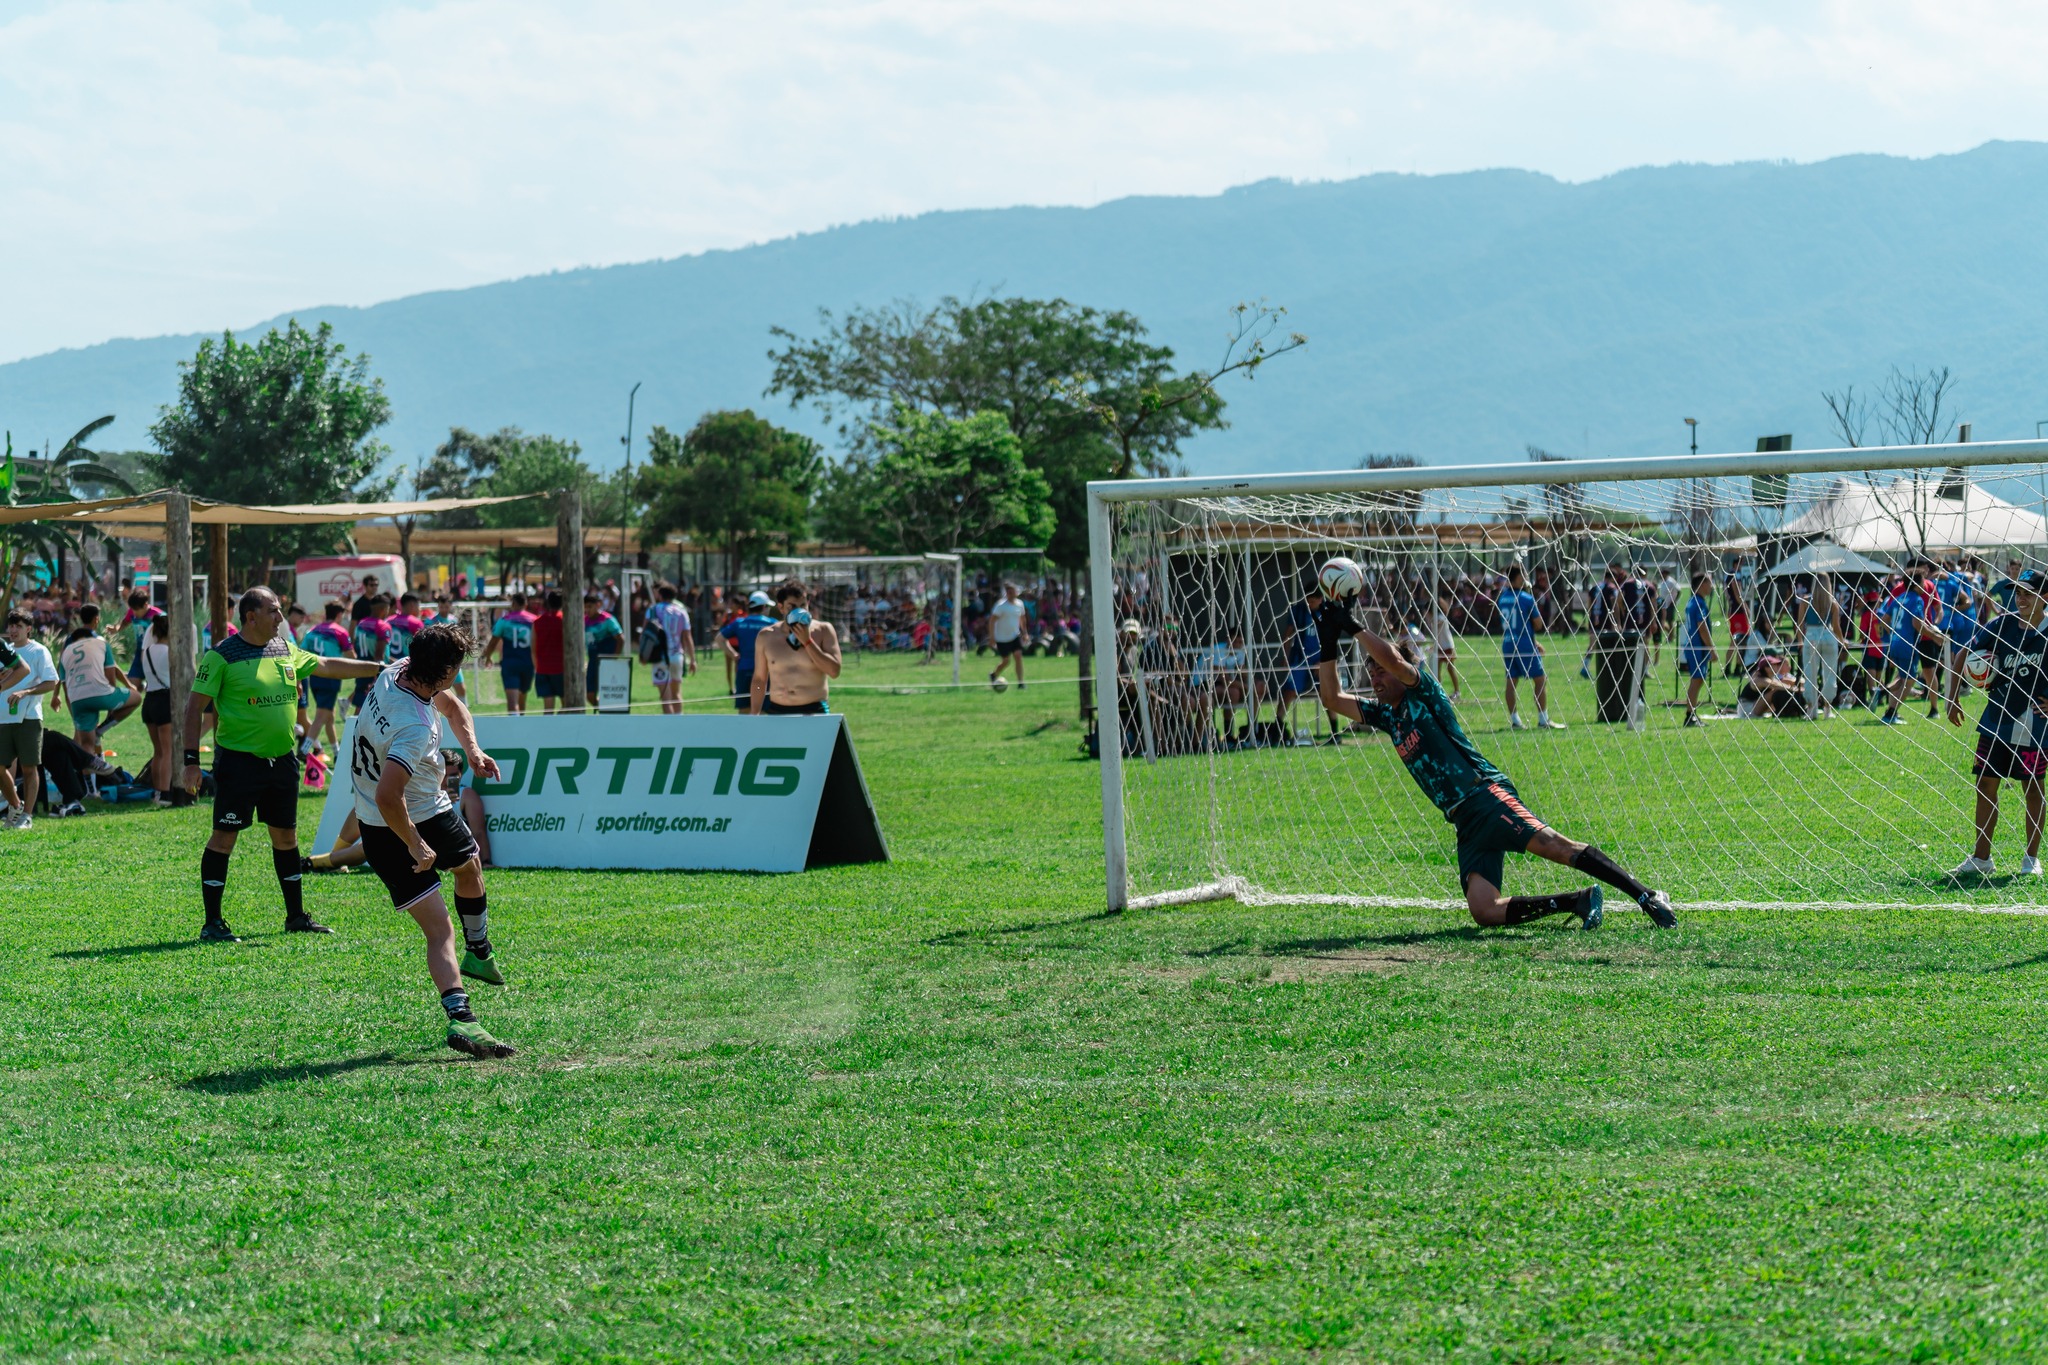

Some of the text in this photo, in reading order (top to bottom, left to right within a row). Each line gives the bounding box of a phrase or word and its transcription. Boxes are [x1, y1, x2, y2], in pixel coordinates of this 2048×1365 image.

[313, 637, 325, 656] 4
[390, 630, 403, 655] 9
[512, 627, 531, 648] 13
[72, 644, 85, 664] 5
[376, 716, 391, 736] FC
[353, 735, 381, 782] 10
[455, 747, 807, 796] ORTING
[596, 811, 732, 835] sporting.com.ar
